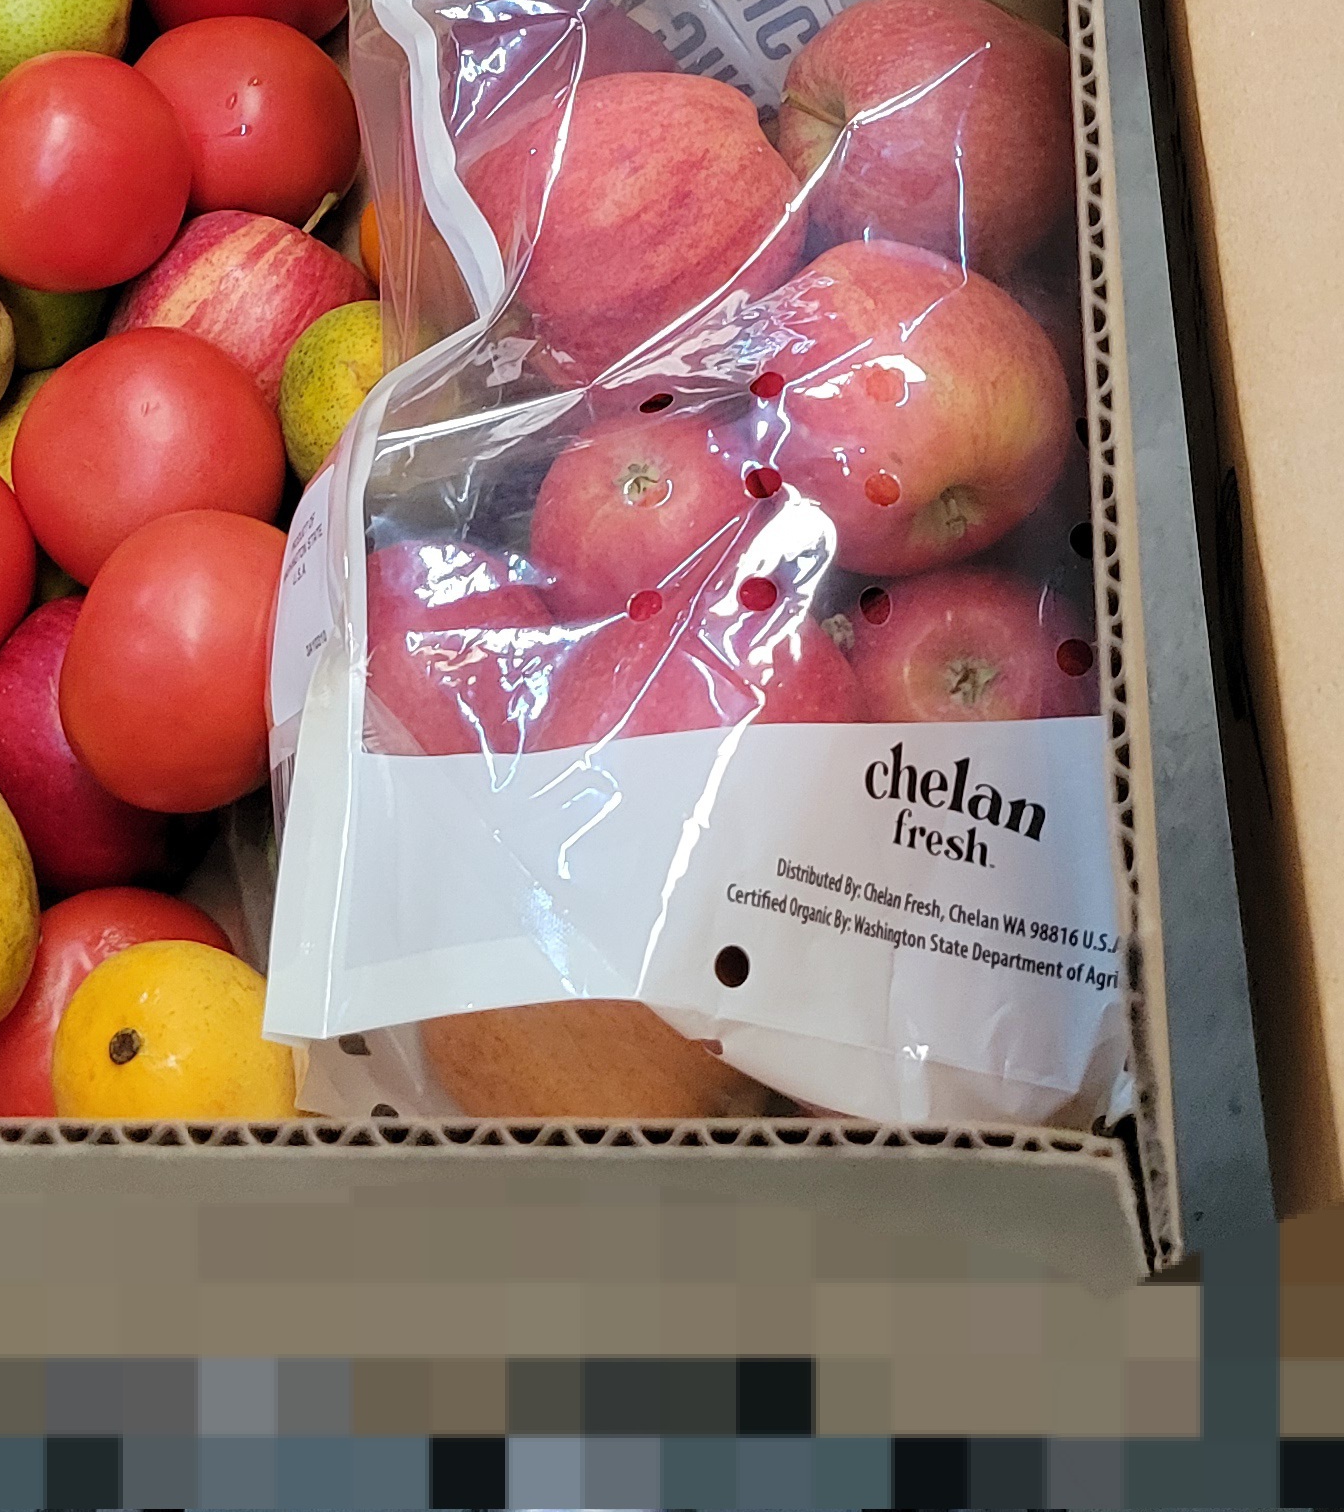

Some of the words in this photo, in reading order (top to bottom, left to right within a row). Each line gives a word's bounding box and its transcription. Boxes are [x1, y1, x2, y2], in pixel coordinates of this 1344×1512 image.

[864, 742, 1047, 842] chelan
[892, 808, 989, 868] fresh
[726, 883, 788, 914] Certified
[789, 897, 833, 925] Organic
[833, 909, 852, 935] By:
[854, 913, 926, 950] Washington
[929, 933, 969, 959] State
[971, 941, 1064, 979] Department
[1066, 963, 1085, 982] of
[777, 857, 844, 893] Distributed
[844, 876, 862, 902] By:
[863, 882, 902, 910] Chelan
[905, 892, 945, 924] Fresh,
[948, 903, 1000, 931] Chelan
[1003, 914, 1026, 937] WA
[1030, 921, 1079, 947] 98816
